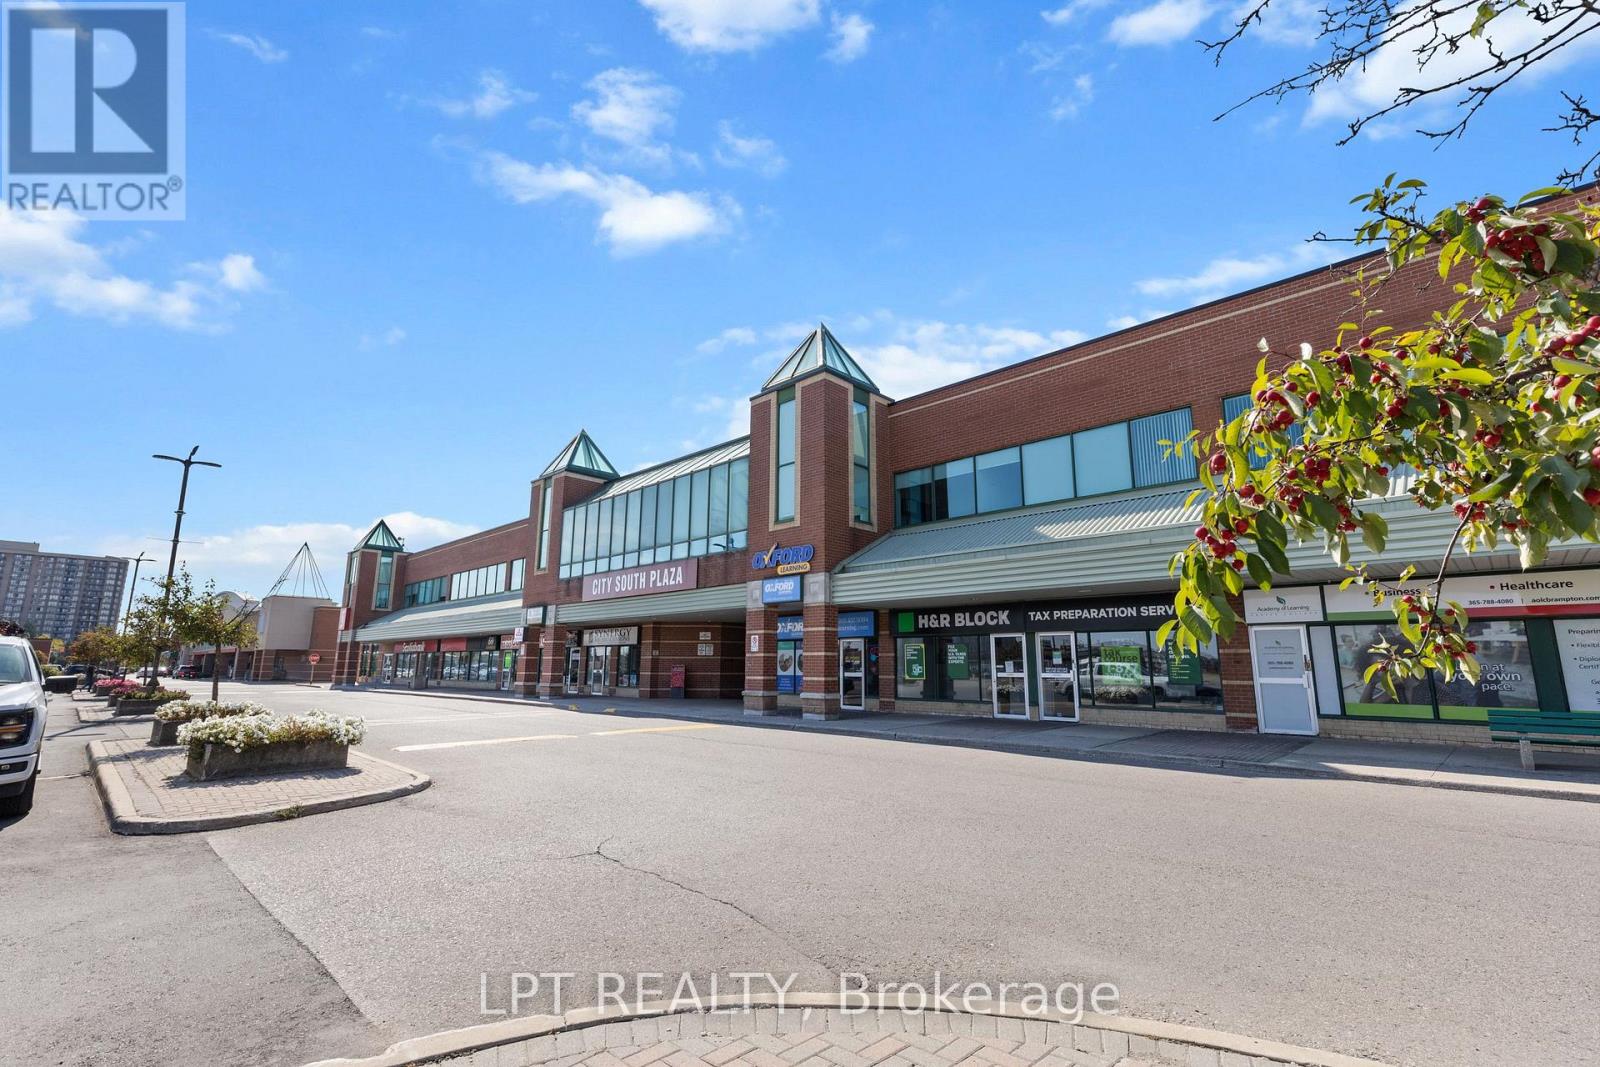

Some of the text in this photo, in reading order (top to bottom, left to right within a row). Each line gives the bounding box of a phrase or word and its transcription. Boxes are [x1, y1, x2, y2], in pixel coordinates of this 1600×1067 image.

[780, 564, 808, 573] LEARNING
[592, 566, 683, 595] CITY SOUTH PLAZA
[1500, 580, 1574, 591] Healthcare
[1028, 605, 1175, 621] TAX PREPARATION SERV
[918, 610, 1010, 628] H&R BLOCK
[1493, 663, 1505, 671] at
[1486, 673, 1521, 681] own
